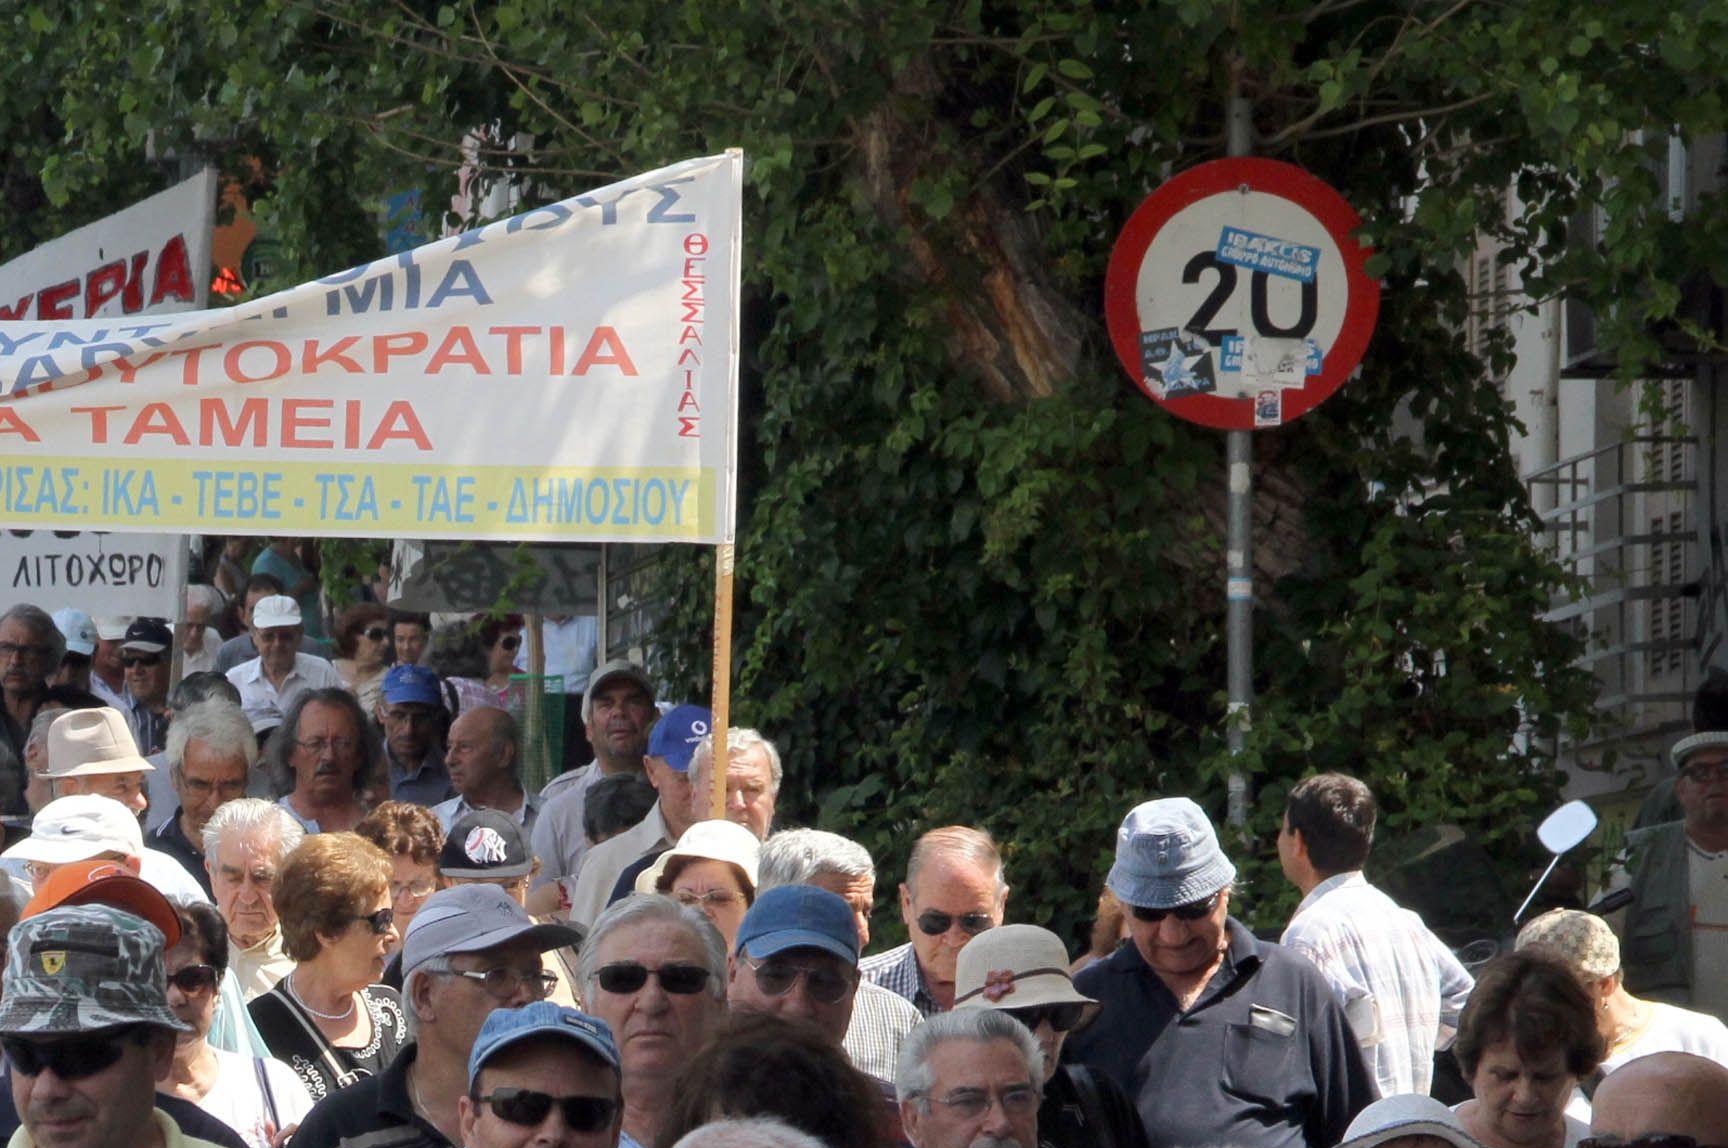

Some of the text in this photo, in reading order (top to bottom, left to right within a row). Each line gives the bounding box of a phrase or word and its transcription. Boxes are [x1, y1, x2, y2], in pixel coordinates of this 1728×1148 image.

[677, 232, 710, 439] ΘΕΣΣΑΛΙΑΣ
[1181, 251, 1319, 347] 20
[70, 396, 434, 451] ΤΑΜΕΙΑ
[102, 468, 160, 516] ΙΚΑ
[191, 470, 283, 519] ΤΕΒΕ
[314, 473, 380, 522] ΤΣΑ
[412, 475, 475, 523] ΤΑΕ
[505, 476, 691, 525] ΔΗΜΟΣΙΟΥ
